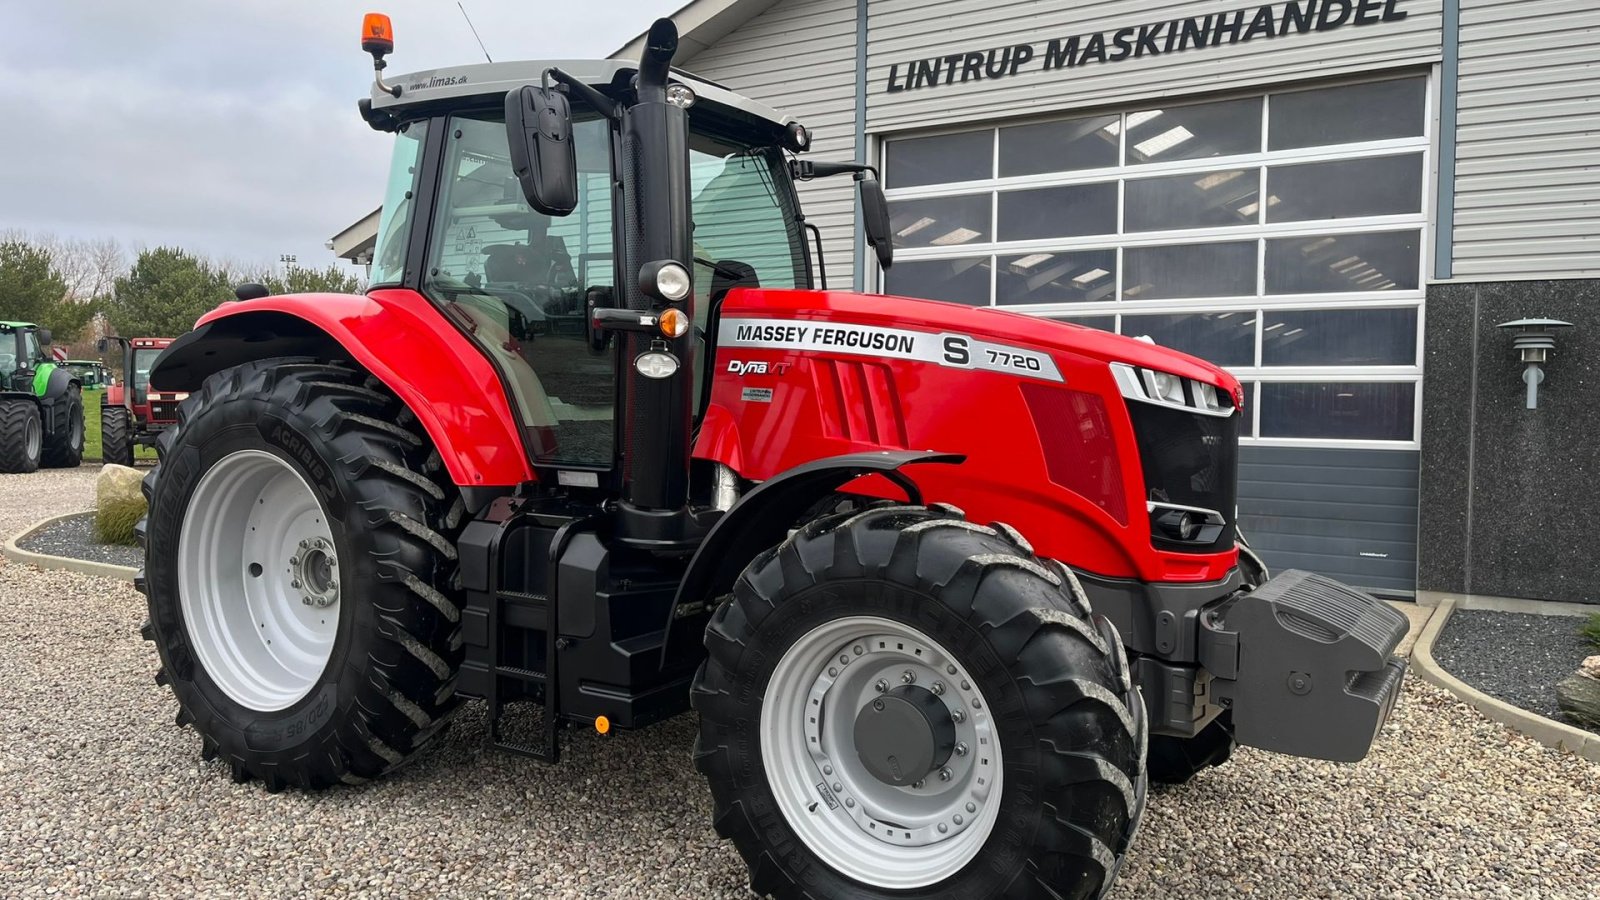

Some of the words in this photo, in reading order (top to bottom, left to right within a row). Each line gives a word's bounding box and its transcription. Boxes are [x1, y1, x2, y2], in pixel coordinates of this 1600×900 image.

[887, 44, 1033, 93] LINTRUP
[1043, 0, 1408, 71] MASKINHANDEL
[410, 75, 468, 90] www.limas.dk
[736, 325, 808, 342] MASSEY
[812, 328, 915, 353] FERGUSON
[943, 336, 970, 364] S
[986, 350, 1041, 371] 7720
[271, 425, 325, 480] AGRIBIB
[319, 477, 337, 502] 2
